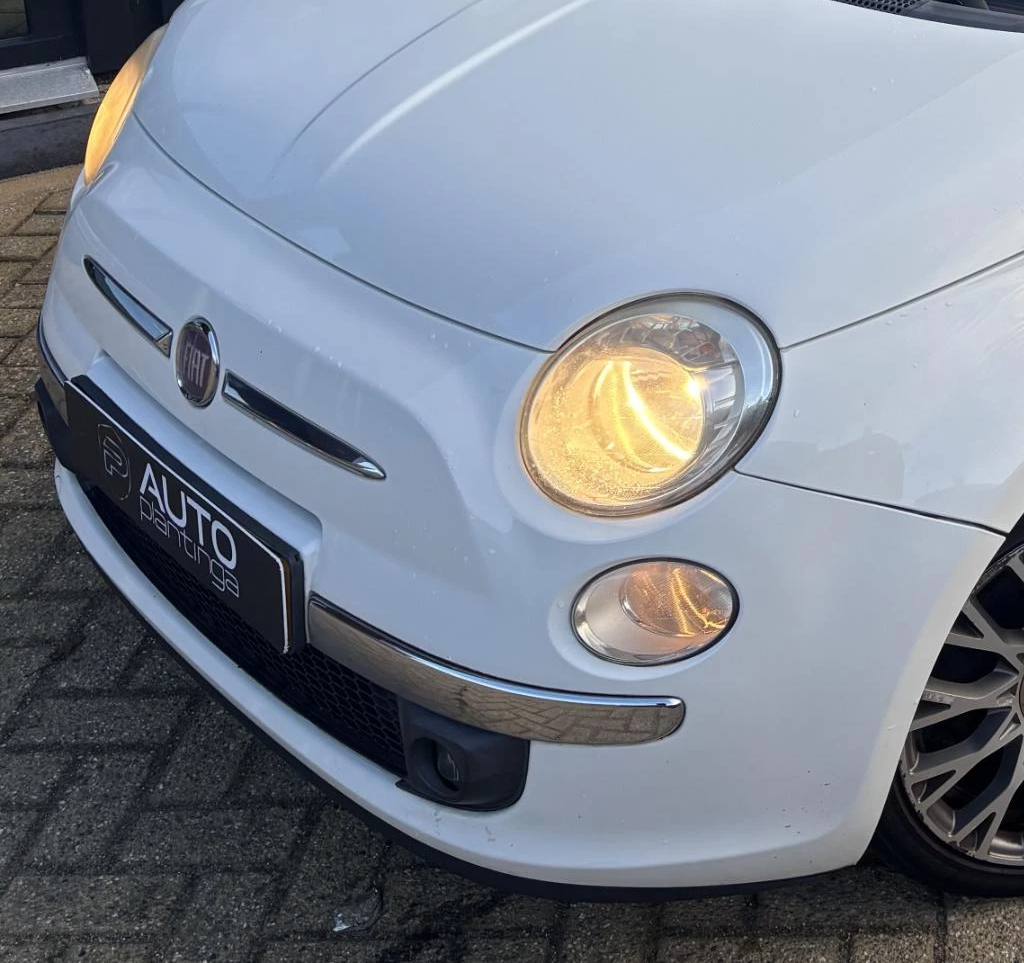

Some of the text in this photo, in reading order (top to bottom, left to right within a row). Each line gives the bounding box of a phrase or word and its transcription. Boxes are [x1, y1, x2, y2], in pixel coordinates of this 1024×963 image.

[182, 341, 210, 388] FIAT
[139, 463, 237, 570] AUTO
[139, 496, 240, 598] plantinga
